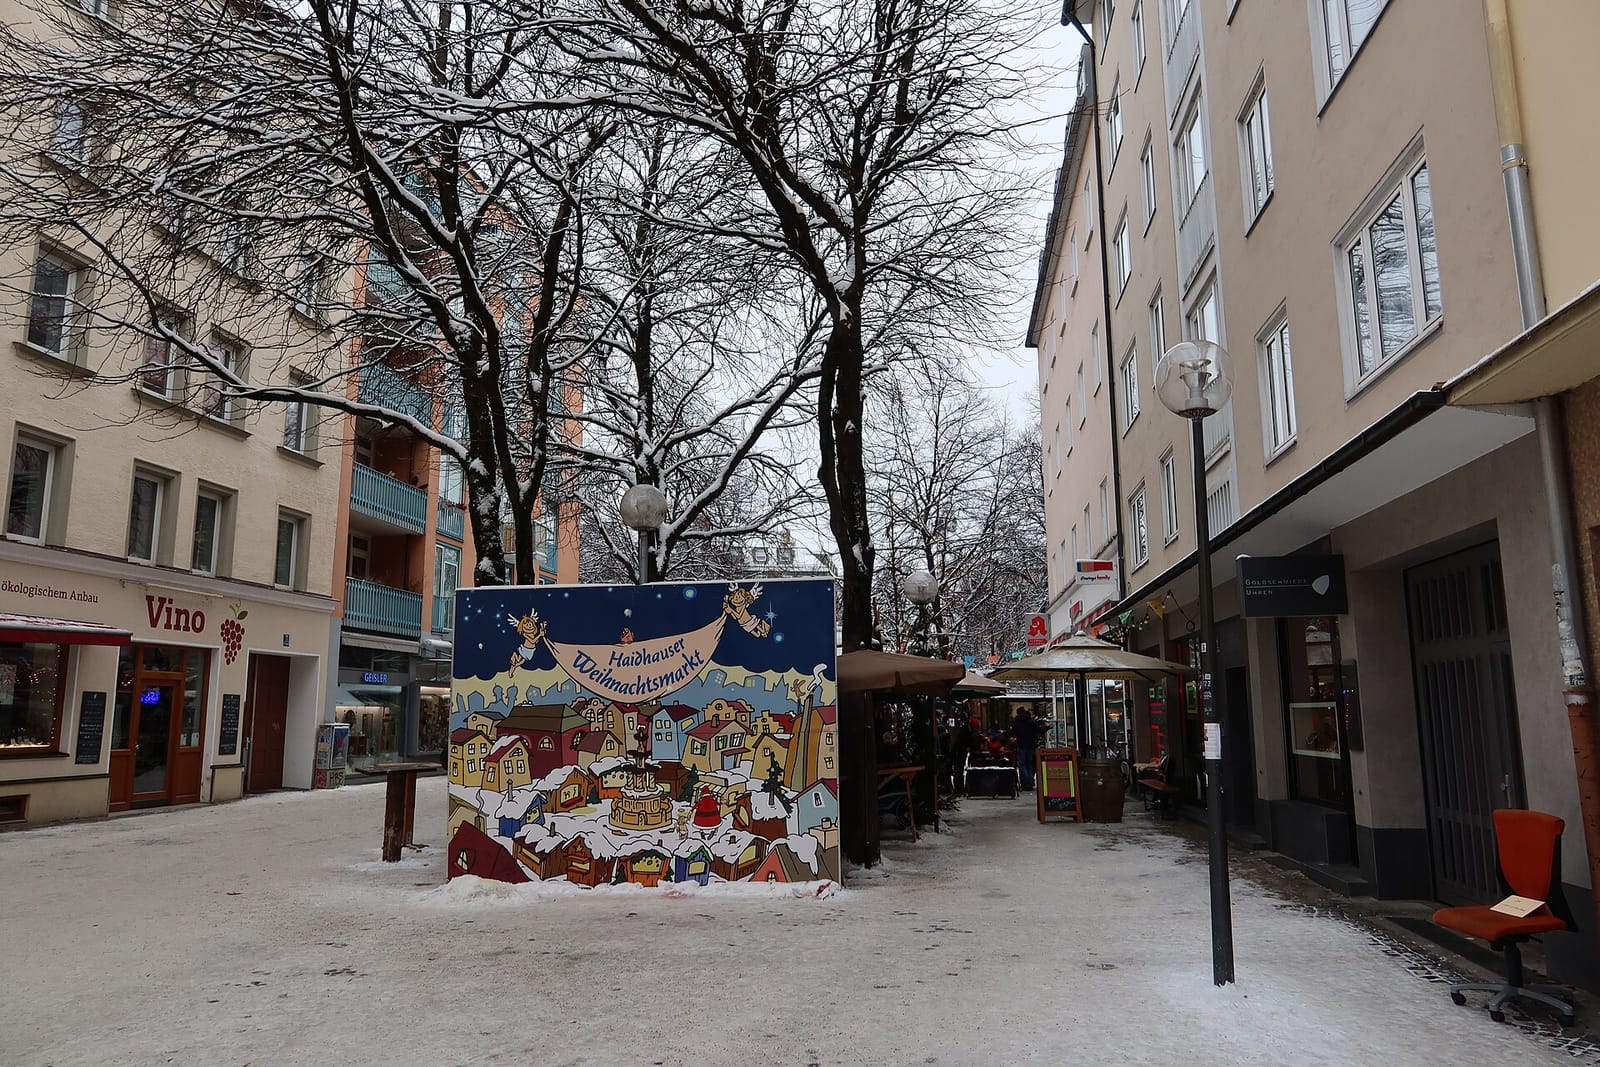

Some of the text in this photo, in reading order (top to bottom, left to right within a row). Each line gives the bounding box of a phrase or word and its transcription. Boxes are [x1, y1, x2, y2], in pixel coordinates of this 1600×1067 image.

[1, 580, 98, 603] ökologischem Anbau
[145, 594, 206, 634] Vino
[608, 637, 686, 668] Haidhauser
[364, 672, 388, 682] GEISLER
[572, 649, 705, 696] Weihnachtsmarkt
